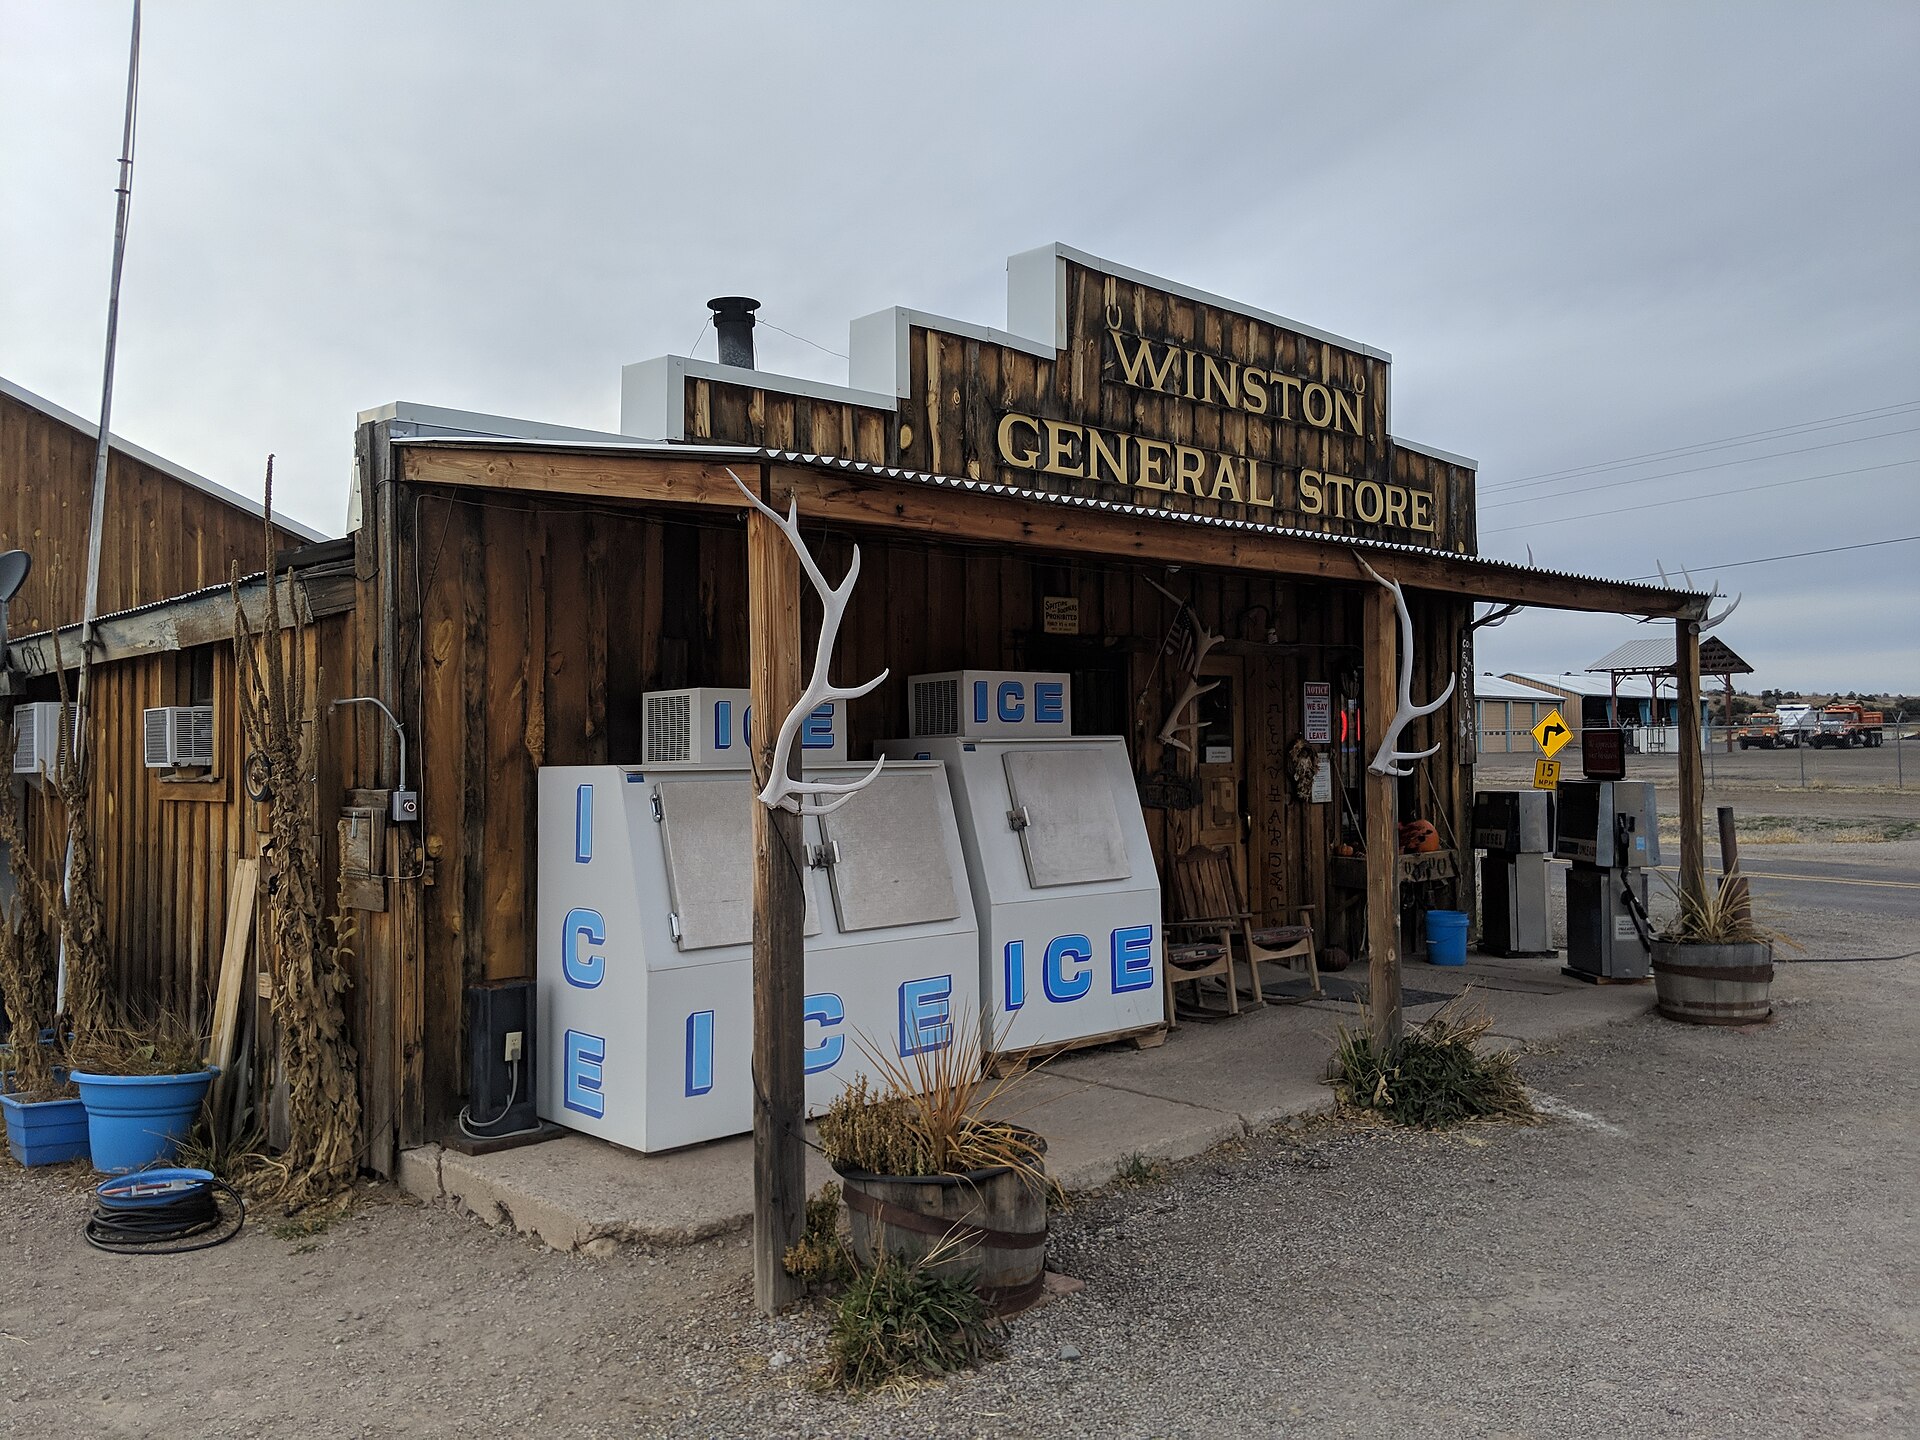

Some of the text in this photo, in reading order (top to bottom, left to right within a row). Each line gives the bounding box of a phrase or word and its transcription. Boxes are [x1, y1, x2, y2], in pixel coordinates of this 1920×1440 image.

[1109, 329, 1366, 436] WINSTON
[997, 412, 1435, 532] GENERAL STORE
[974, 680, 1064, 724] ICE
[1306, 685, 1328, 696] NOTICE
[1307, 703, 1328, 711] WE SAY
[714, 700, 835, 750] IE
[1309, 732, 1327, 740] LEAVE
[1542, 763, 1554, 777] 15
[1479, 832, 1503, 846] DIESEL
[562, 784, 606, 1119] ICE
[1003, 924, 1154, 1013] ICE
[684, 974, 954, 1098] ICE
